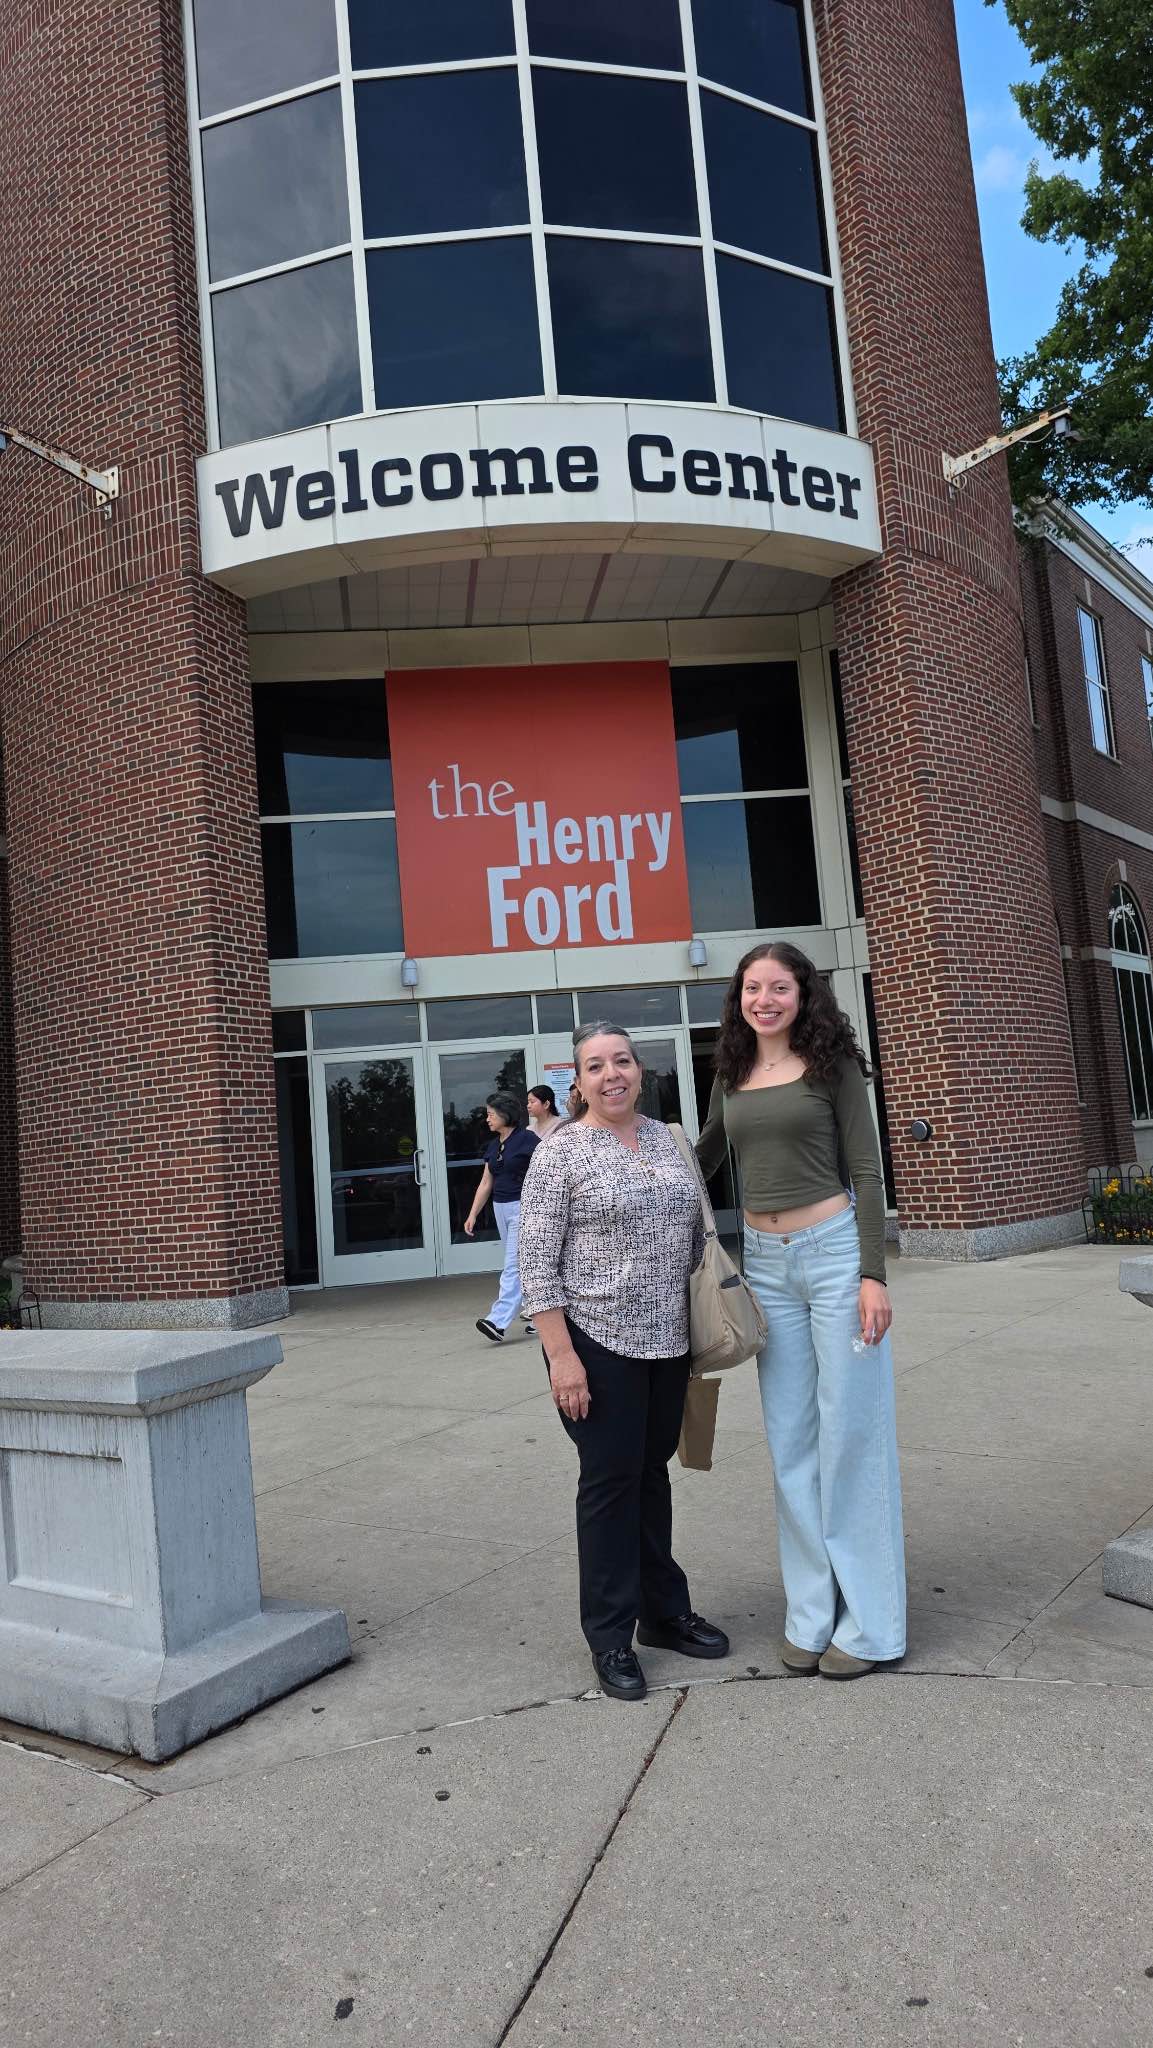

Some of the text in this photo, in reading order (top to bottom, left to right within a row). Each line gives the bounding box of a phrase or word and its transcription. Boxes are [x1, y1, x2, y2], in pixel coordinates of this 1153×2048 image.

[215, 434, 862, 537] Welcome Center
[427, 763, 516, 820] the
[514, 801, 672, 872] Henry
[487, 859, 634, 948] Ford
